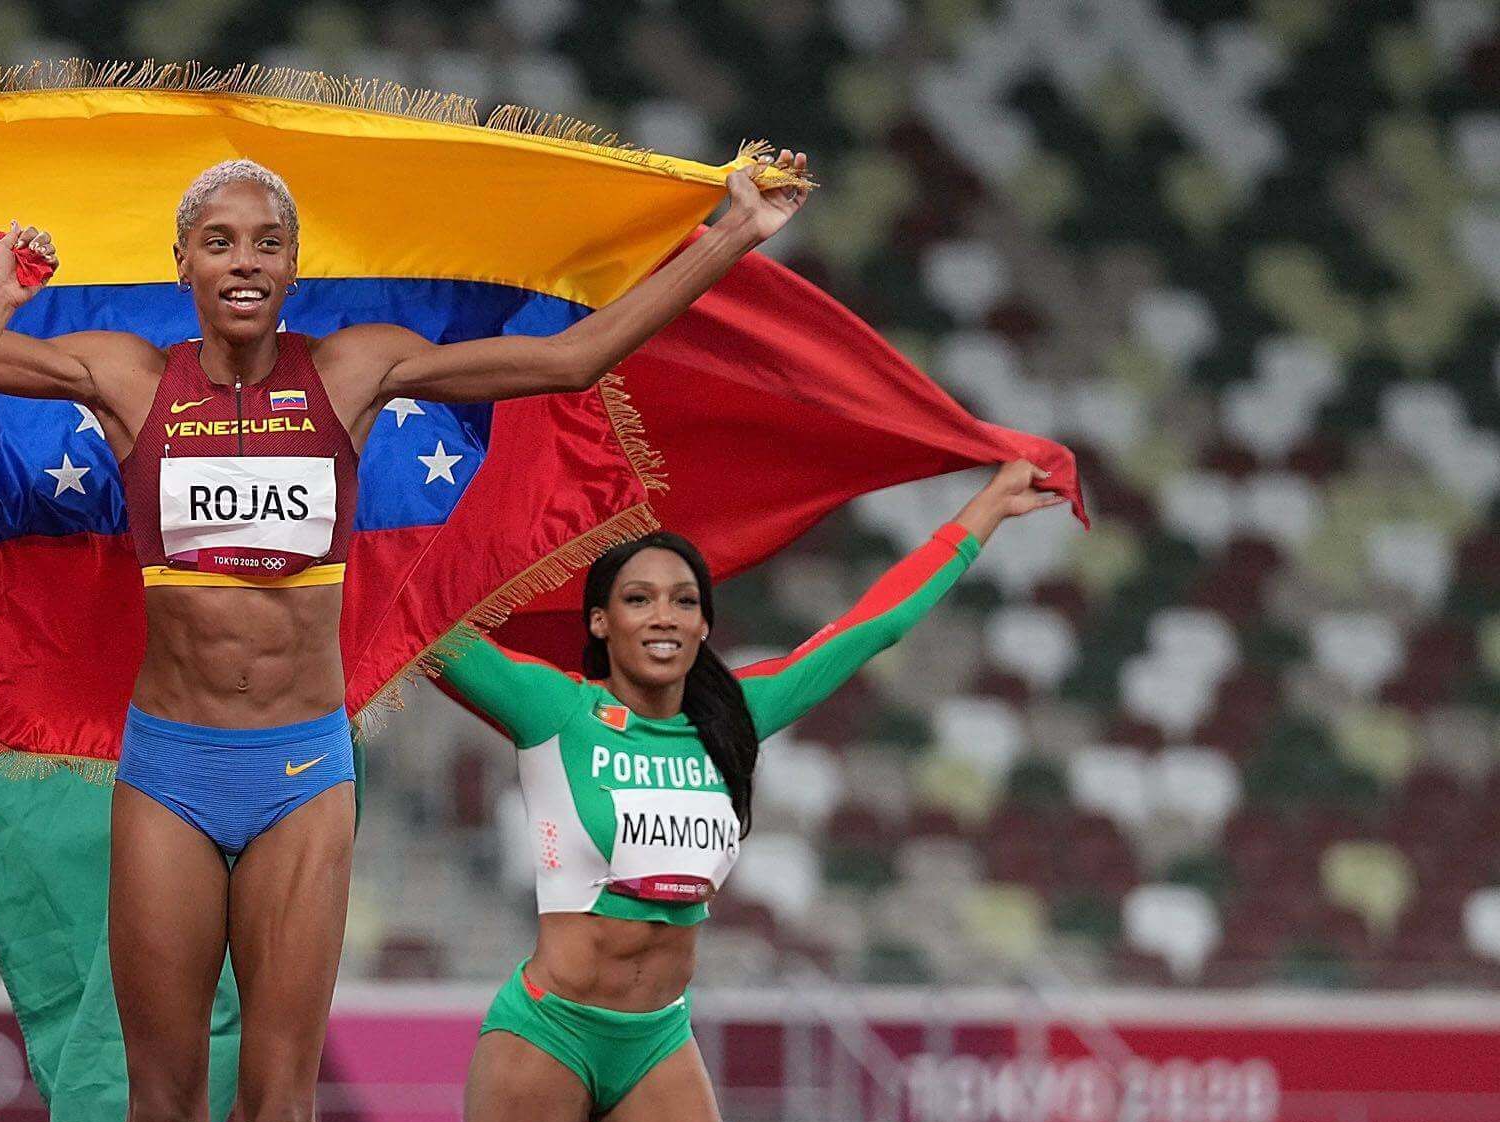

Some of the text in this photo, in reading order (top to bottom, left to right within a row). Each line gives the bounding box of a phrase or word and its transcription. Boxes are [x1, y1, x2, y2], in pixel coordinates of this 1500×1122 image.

[164, 416, 316, 438] VENEZUELA
[189, 484, 309, 521] ROJAS
[214, 556, 259, 567] TOKYO 2020
[591, 745, 726, 788] PORTUGA
[621, 813, 738, 854] MAMONA
